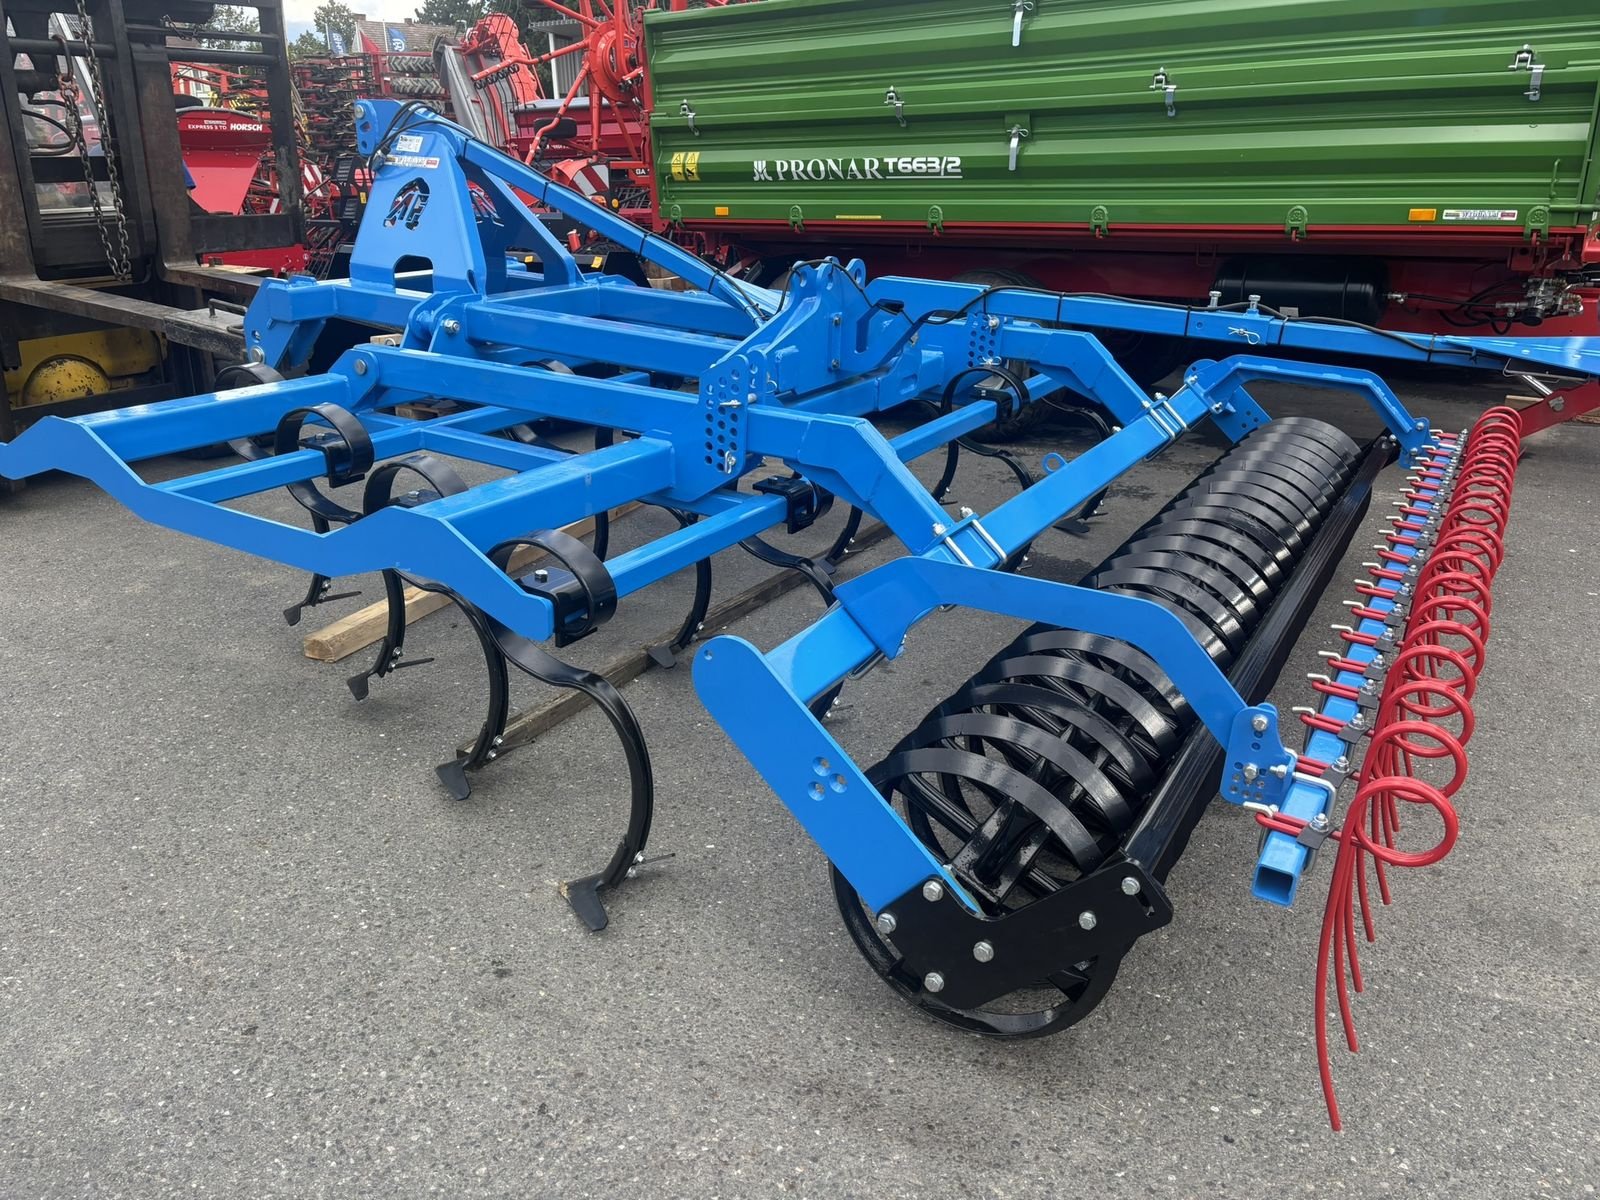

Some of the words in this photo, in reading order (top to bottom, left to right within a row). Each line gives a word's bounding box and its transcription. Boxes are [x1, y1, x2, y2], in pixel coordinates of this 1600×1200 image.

[230, 123, 263, 131] HORSCH
[774, 157, 884, 181] PRONAR
[884, 156, 962, 176] T663/2
